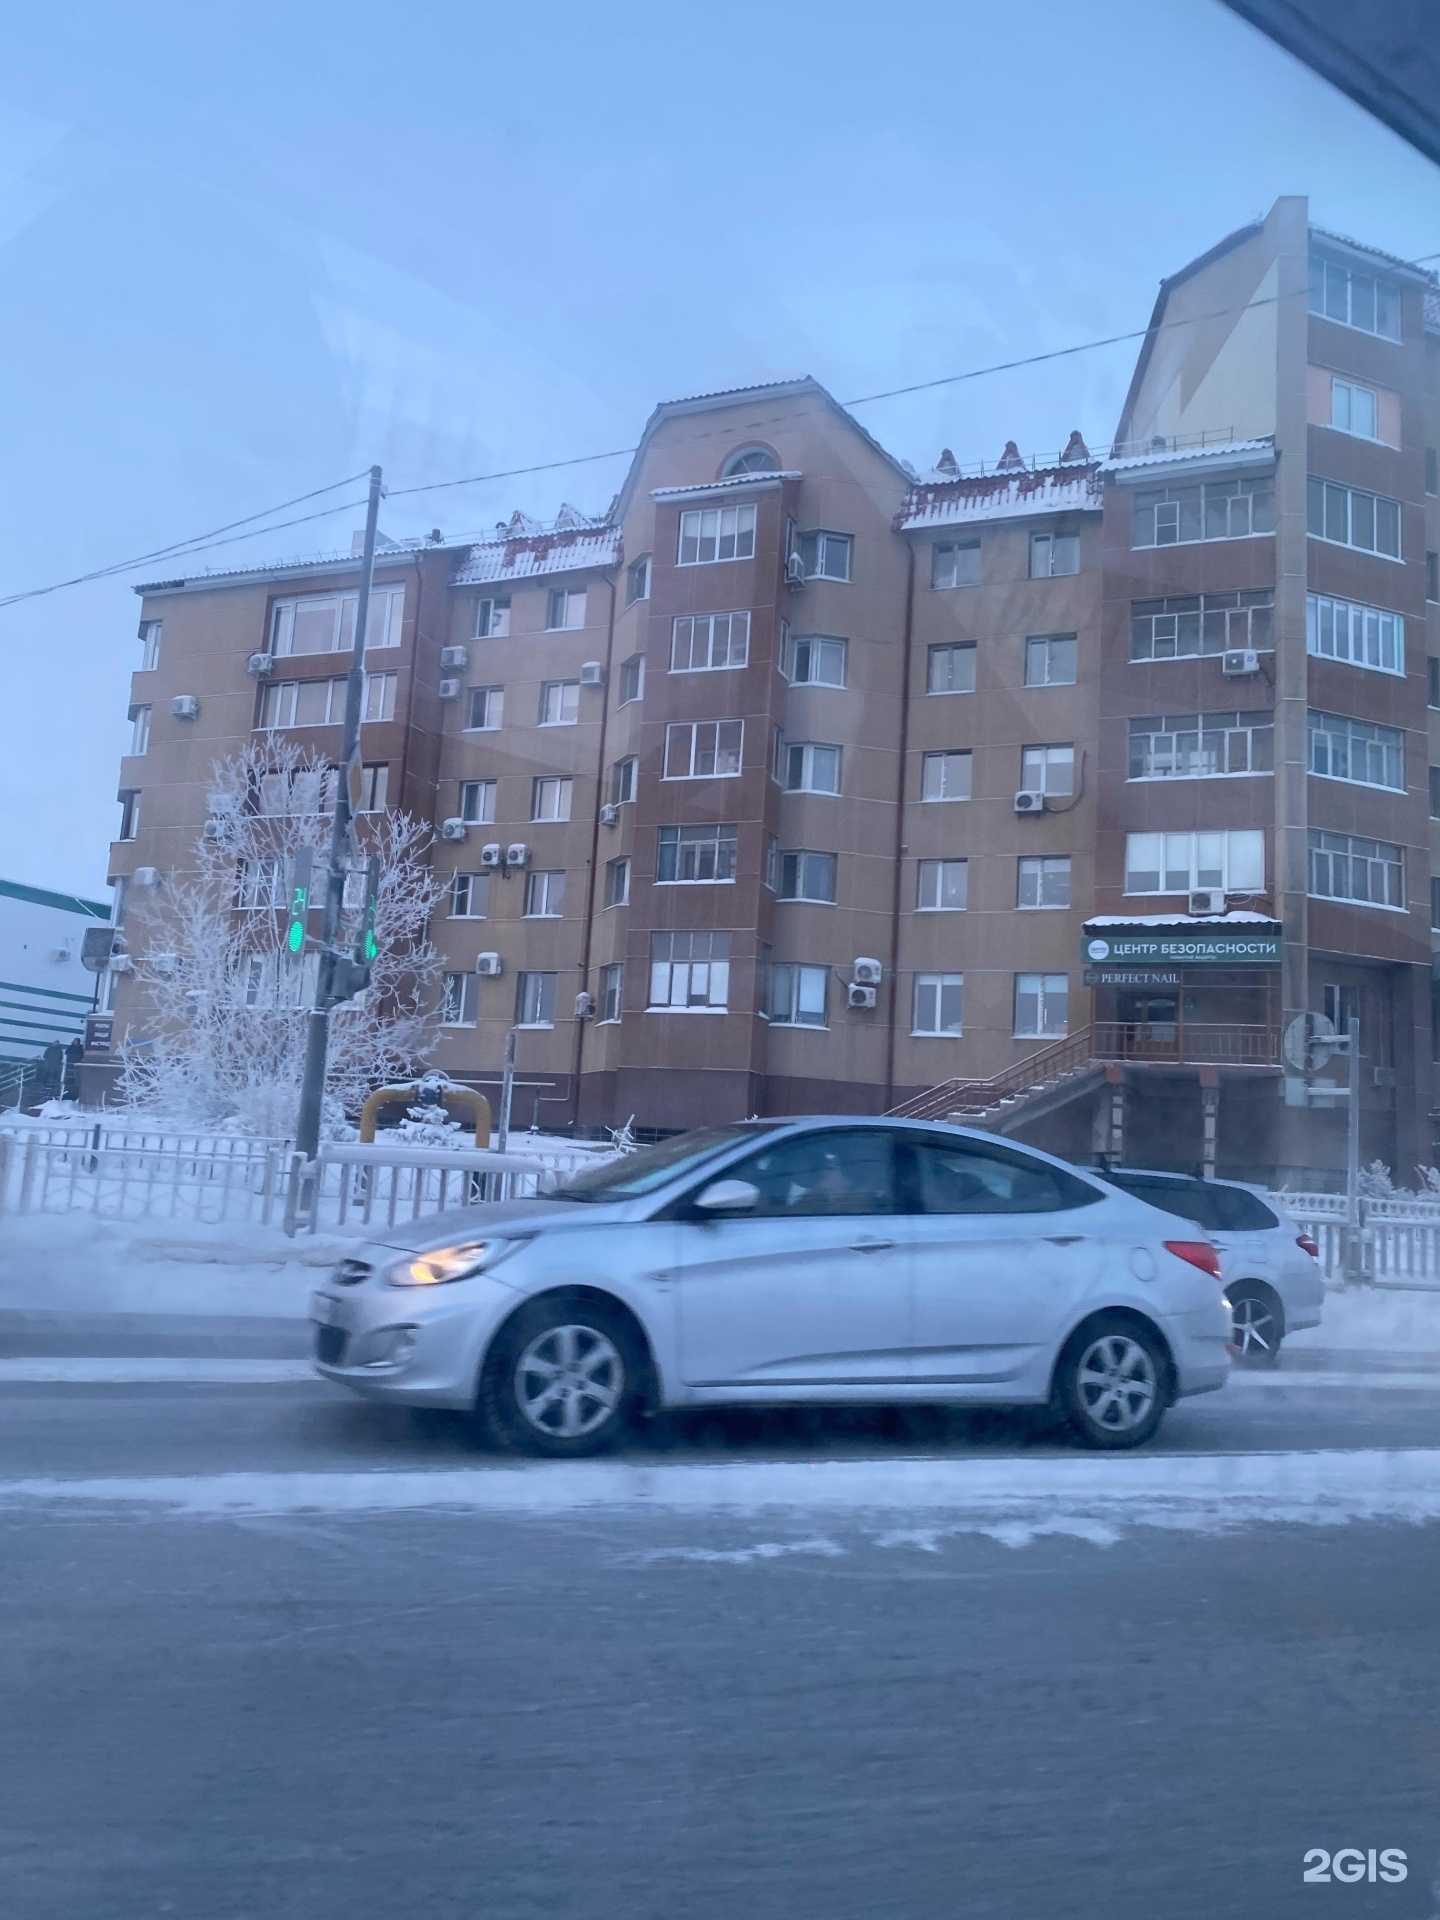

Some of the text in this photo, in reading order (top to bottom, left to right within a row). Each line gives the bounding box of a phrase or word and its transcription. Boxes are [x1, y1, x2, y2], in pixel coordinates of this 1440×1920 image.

[1113, 943, 1157, 956] ЦЕНТР
[1161, 943, 1276, 955] БЕЗОПАСНОСТИ
[1101, 973, 1181, 984] PERFECT NAIL
